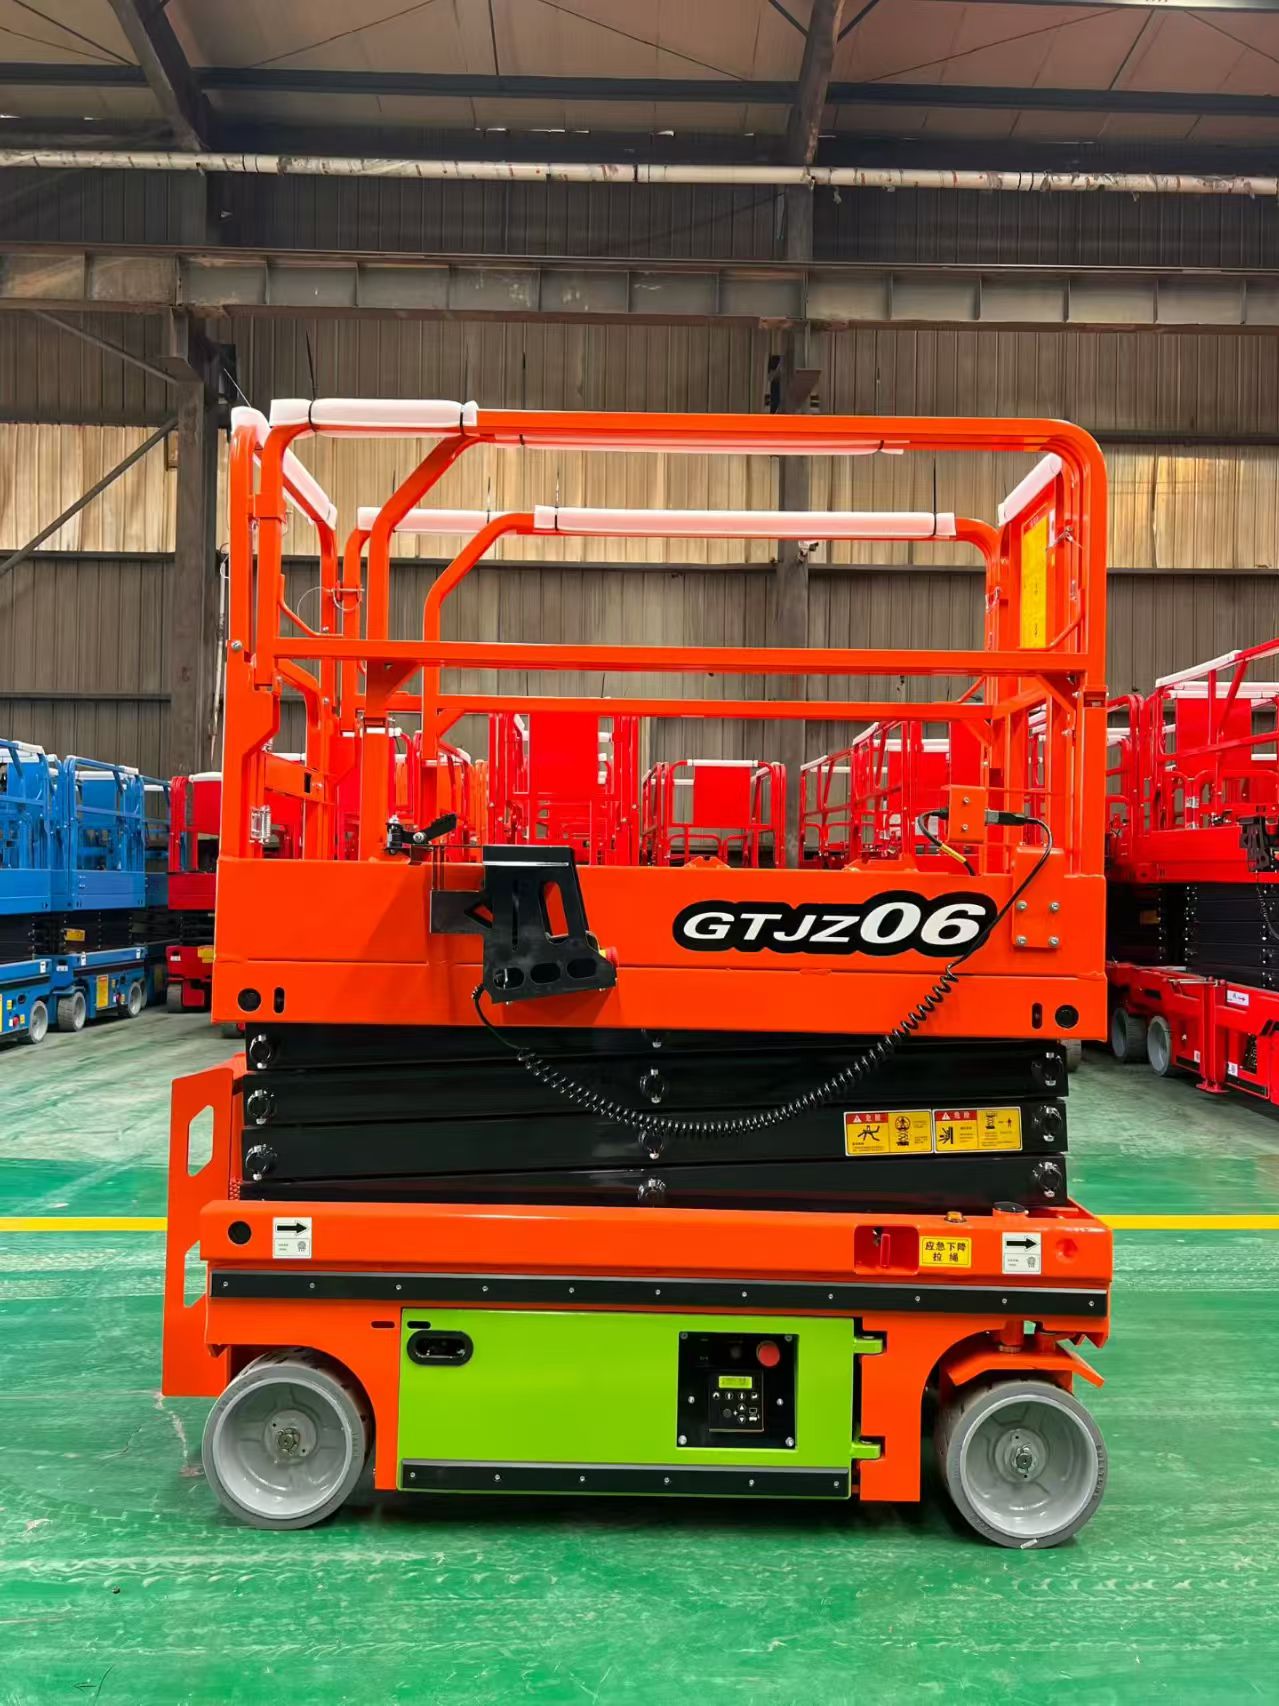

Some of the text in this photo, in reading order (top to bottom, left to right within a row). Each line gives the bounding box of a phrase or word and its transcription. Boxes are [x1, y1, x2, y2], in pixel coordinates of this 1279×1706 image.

[683, 902, 987, 945] GTJZ06
[925, 1241, 966, 1251] 应急下降
